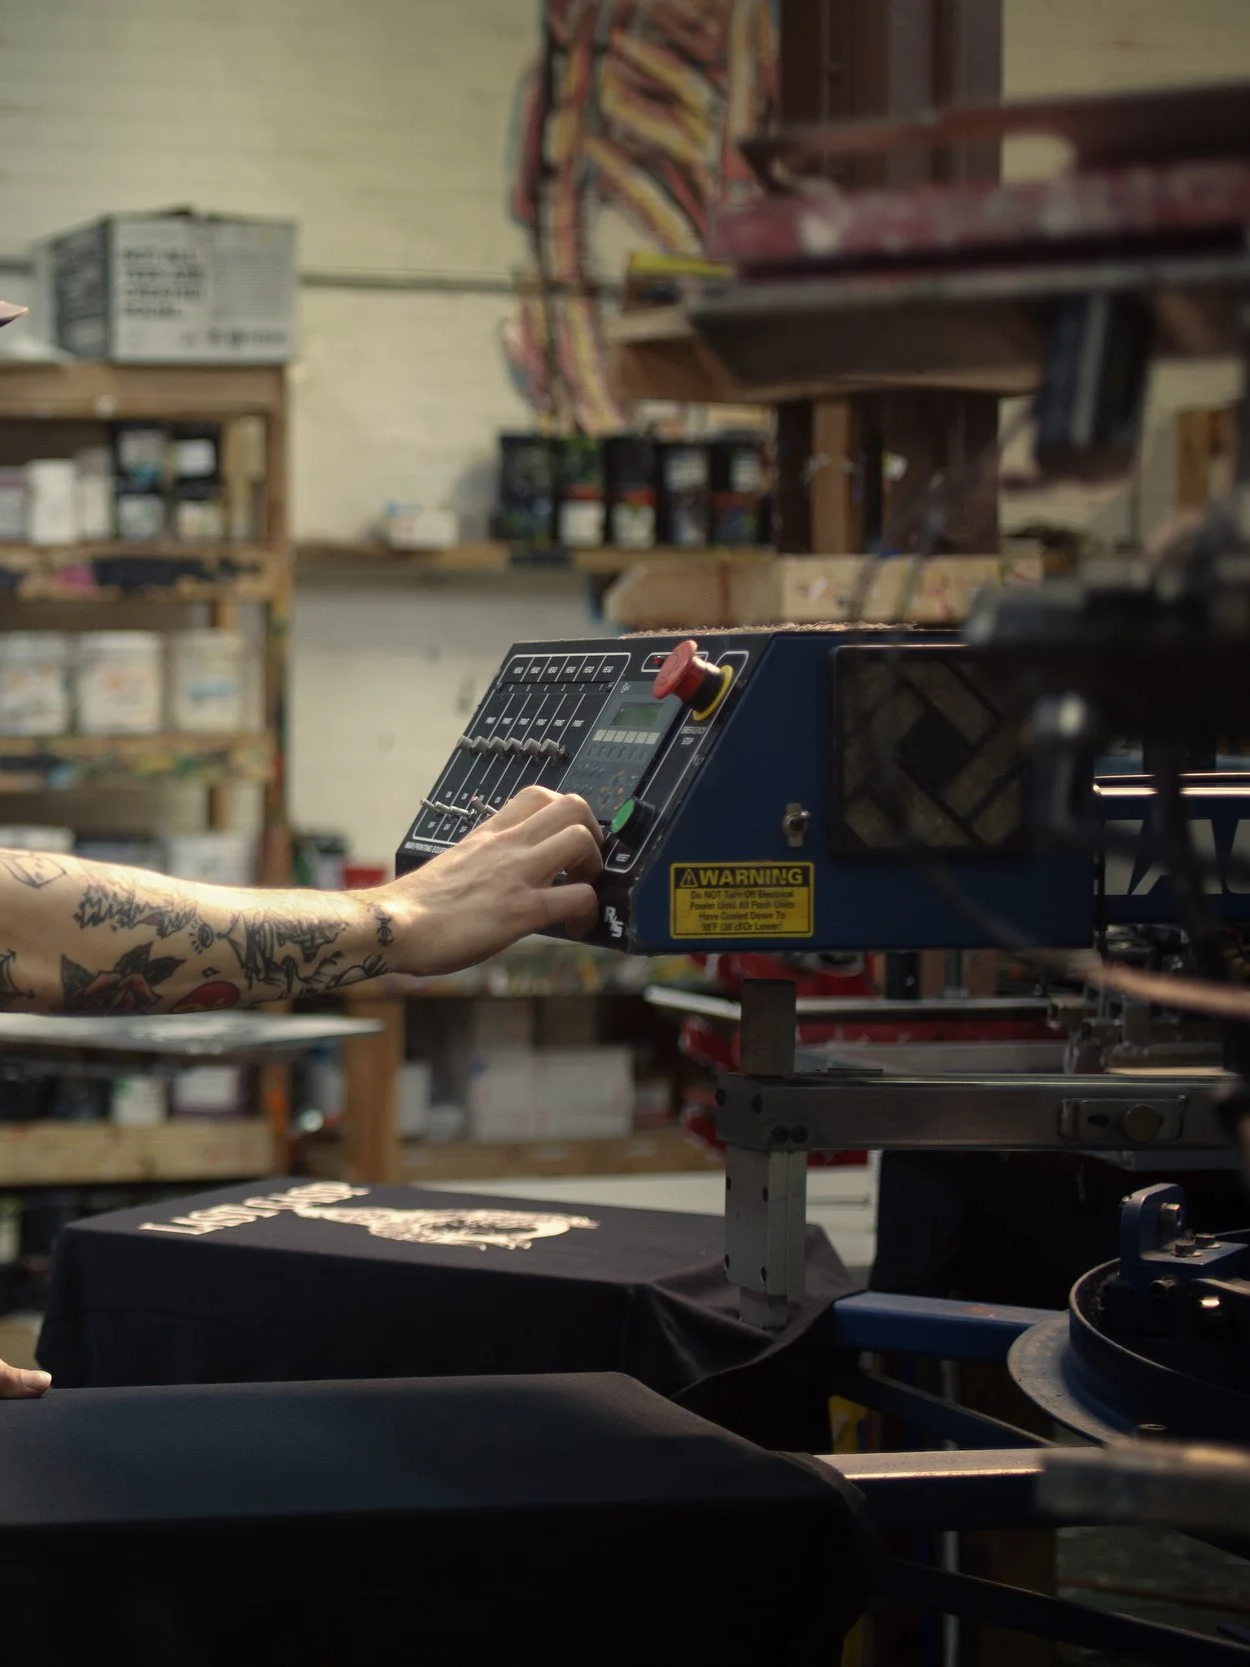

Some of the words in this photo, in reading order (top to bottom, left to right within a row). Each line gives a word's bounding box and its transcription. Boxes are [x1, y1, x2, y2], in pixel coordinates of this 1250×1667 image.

[699, 869, 803, 885] WARNING
[691, 891, 701, 899] Do
[704, 891, 721, 899] NOT
[725, 890, 743, 899] Turn
[744, 890, 757, 899] Off
[758, 889, 794, 898] Electrical
[717, 901, 737, 909] Until
[739, 901, 750, 909] All
[751, 901, 772, 909] Flash
[774, 900, 795, 909] Units
[699, 912, 718, 920] Have
[721, 911, 748, 920] Cooled
[750, 911, 774, 919] Down
[776, 910, 786, 919] To
